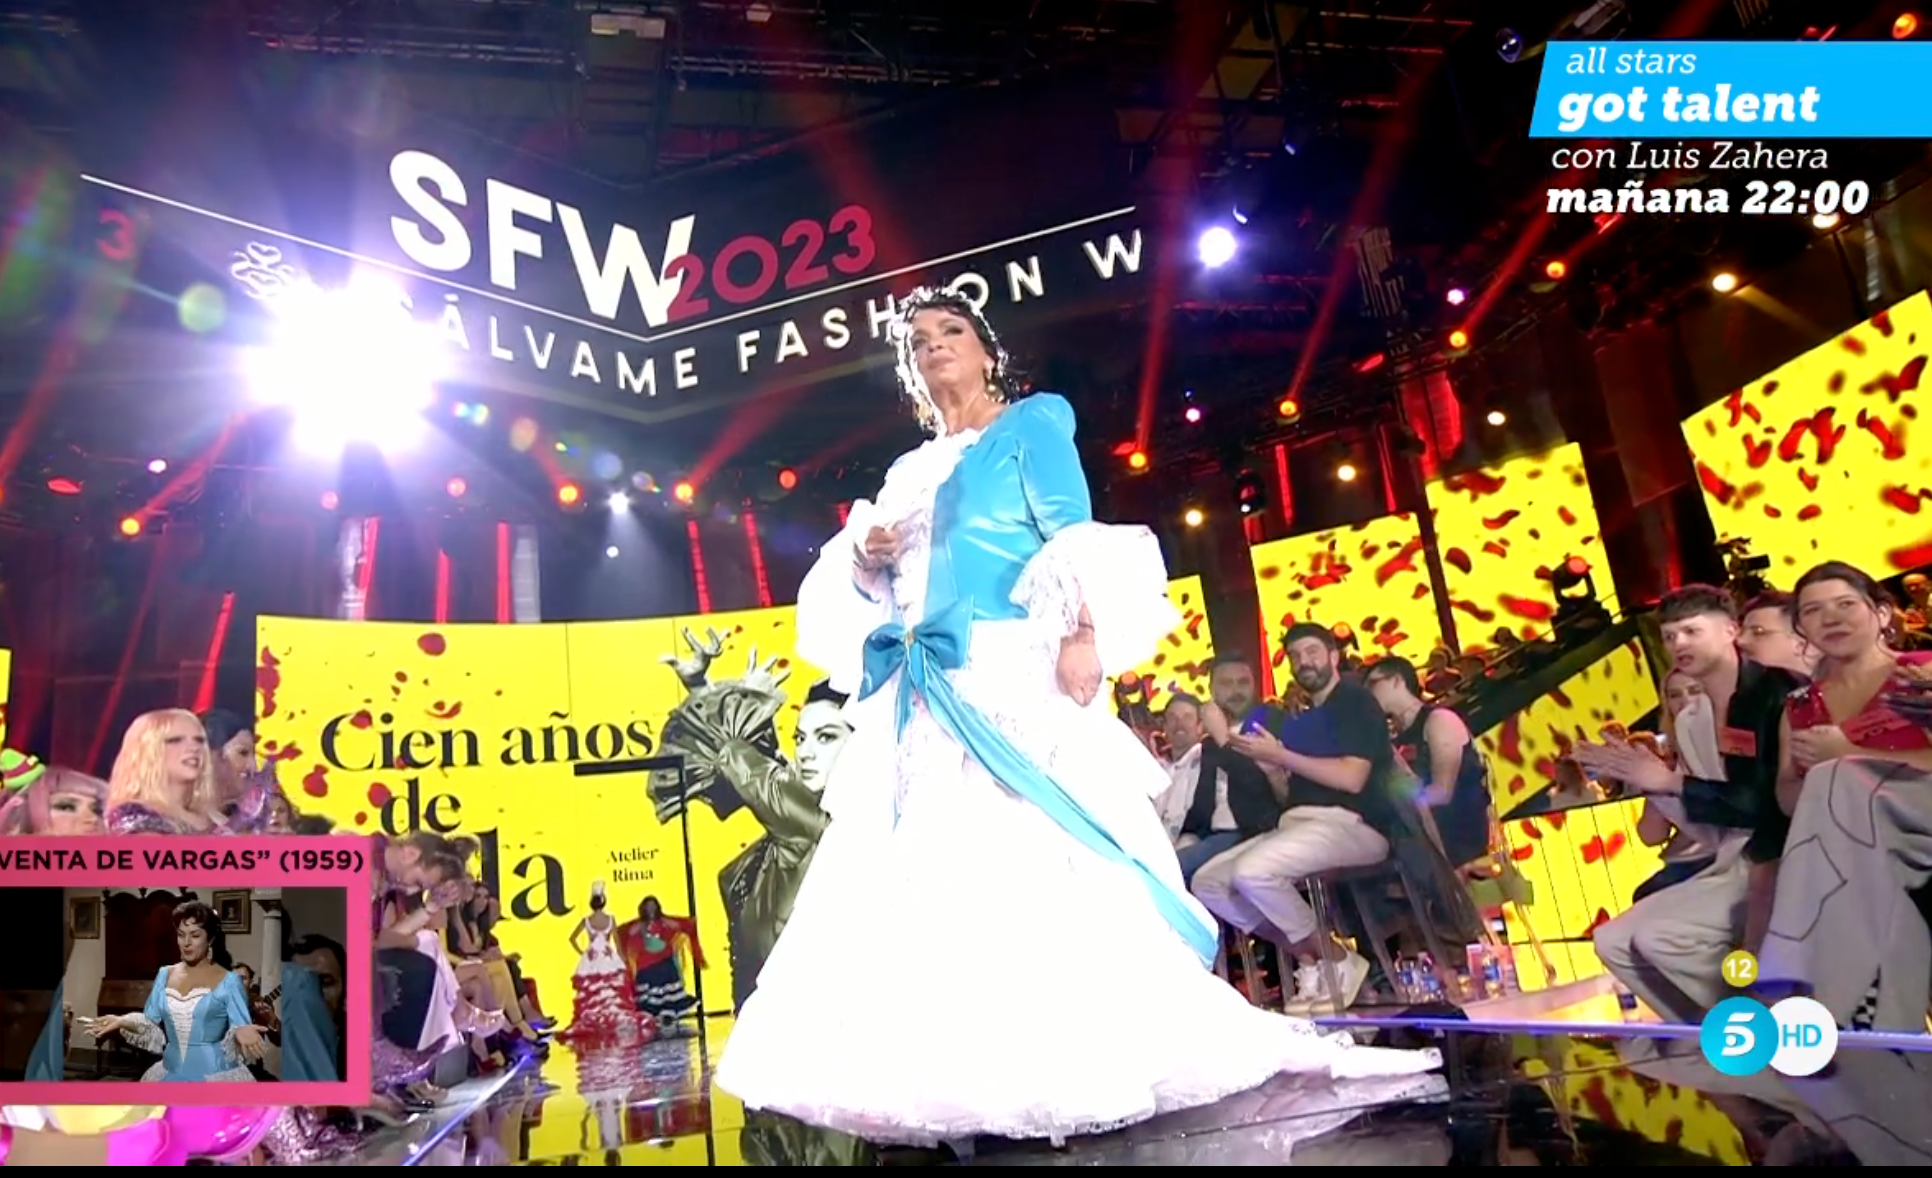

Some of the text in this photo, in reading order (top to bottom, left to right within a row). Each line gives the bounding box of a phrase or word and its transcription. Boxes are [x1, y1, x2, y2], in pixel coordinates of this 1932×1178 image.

[389, 150, 877, 328] SFW 2023
[398, 292, 699, 397] ÁLVAME
[736, 255, 1044, 372] FASHON
[320, 711, 654, 772] Cien años
[380, 776, 463, 836] de
[606, 846, 660, 863] Atelier
[613, 868, 653, 882] Rima
